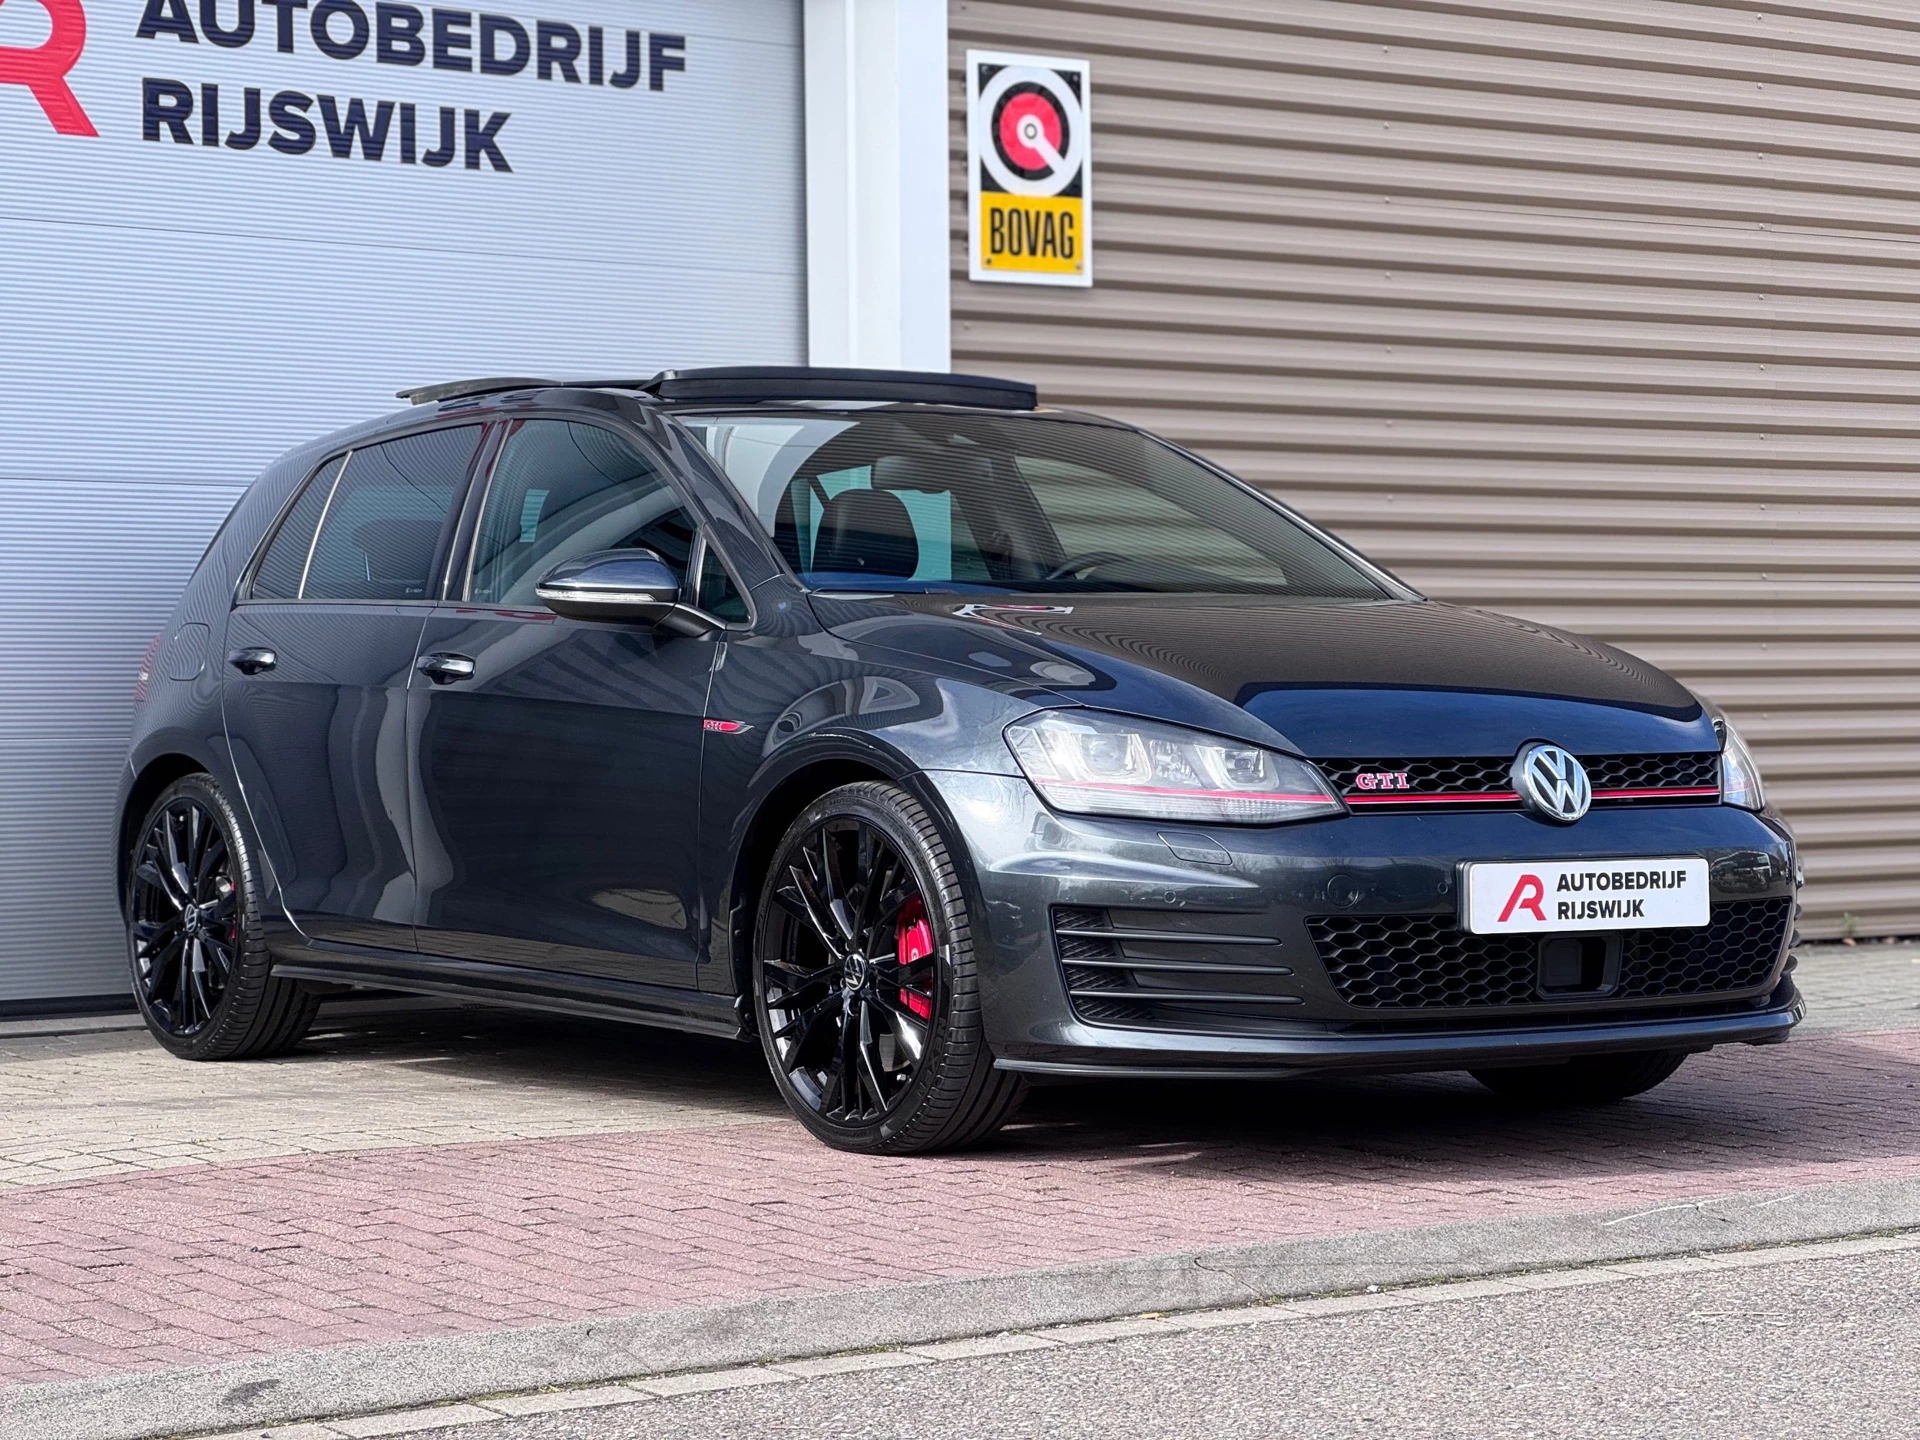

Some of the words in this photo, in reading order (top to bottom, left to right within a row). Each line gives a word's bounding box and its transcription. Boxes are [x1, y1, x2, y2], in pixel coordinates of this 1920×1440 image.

[135, 0, 686, 92] AUTOBEDRIJF
[142, 77, 513, 174] RIJSWIJK
[990, 208, 1074, 259] BOVAG
[1355, 772, 1410, 790] GTI
[1556, 870, 1687, 892] AUTOBEDRIJF
[1557, 899, 1645, 920] RIJSWIJK
